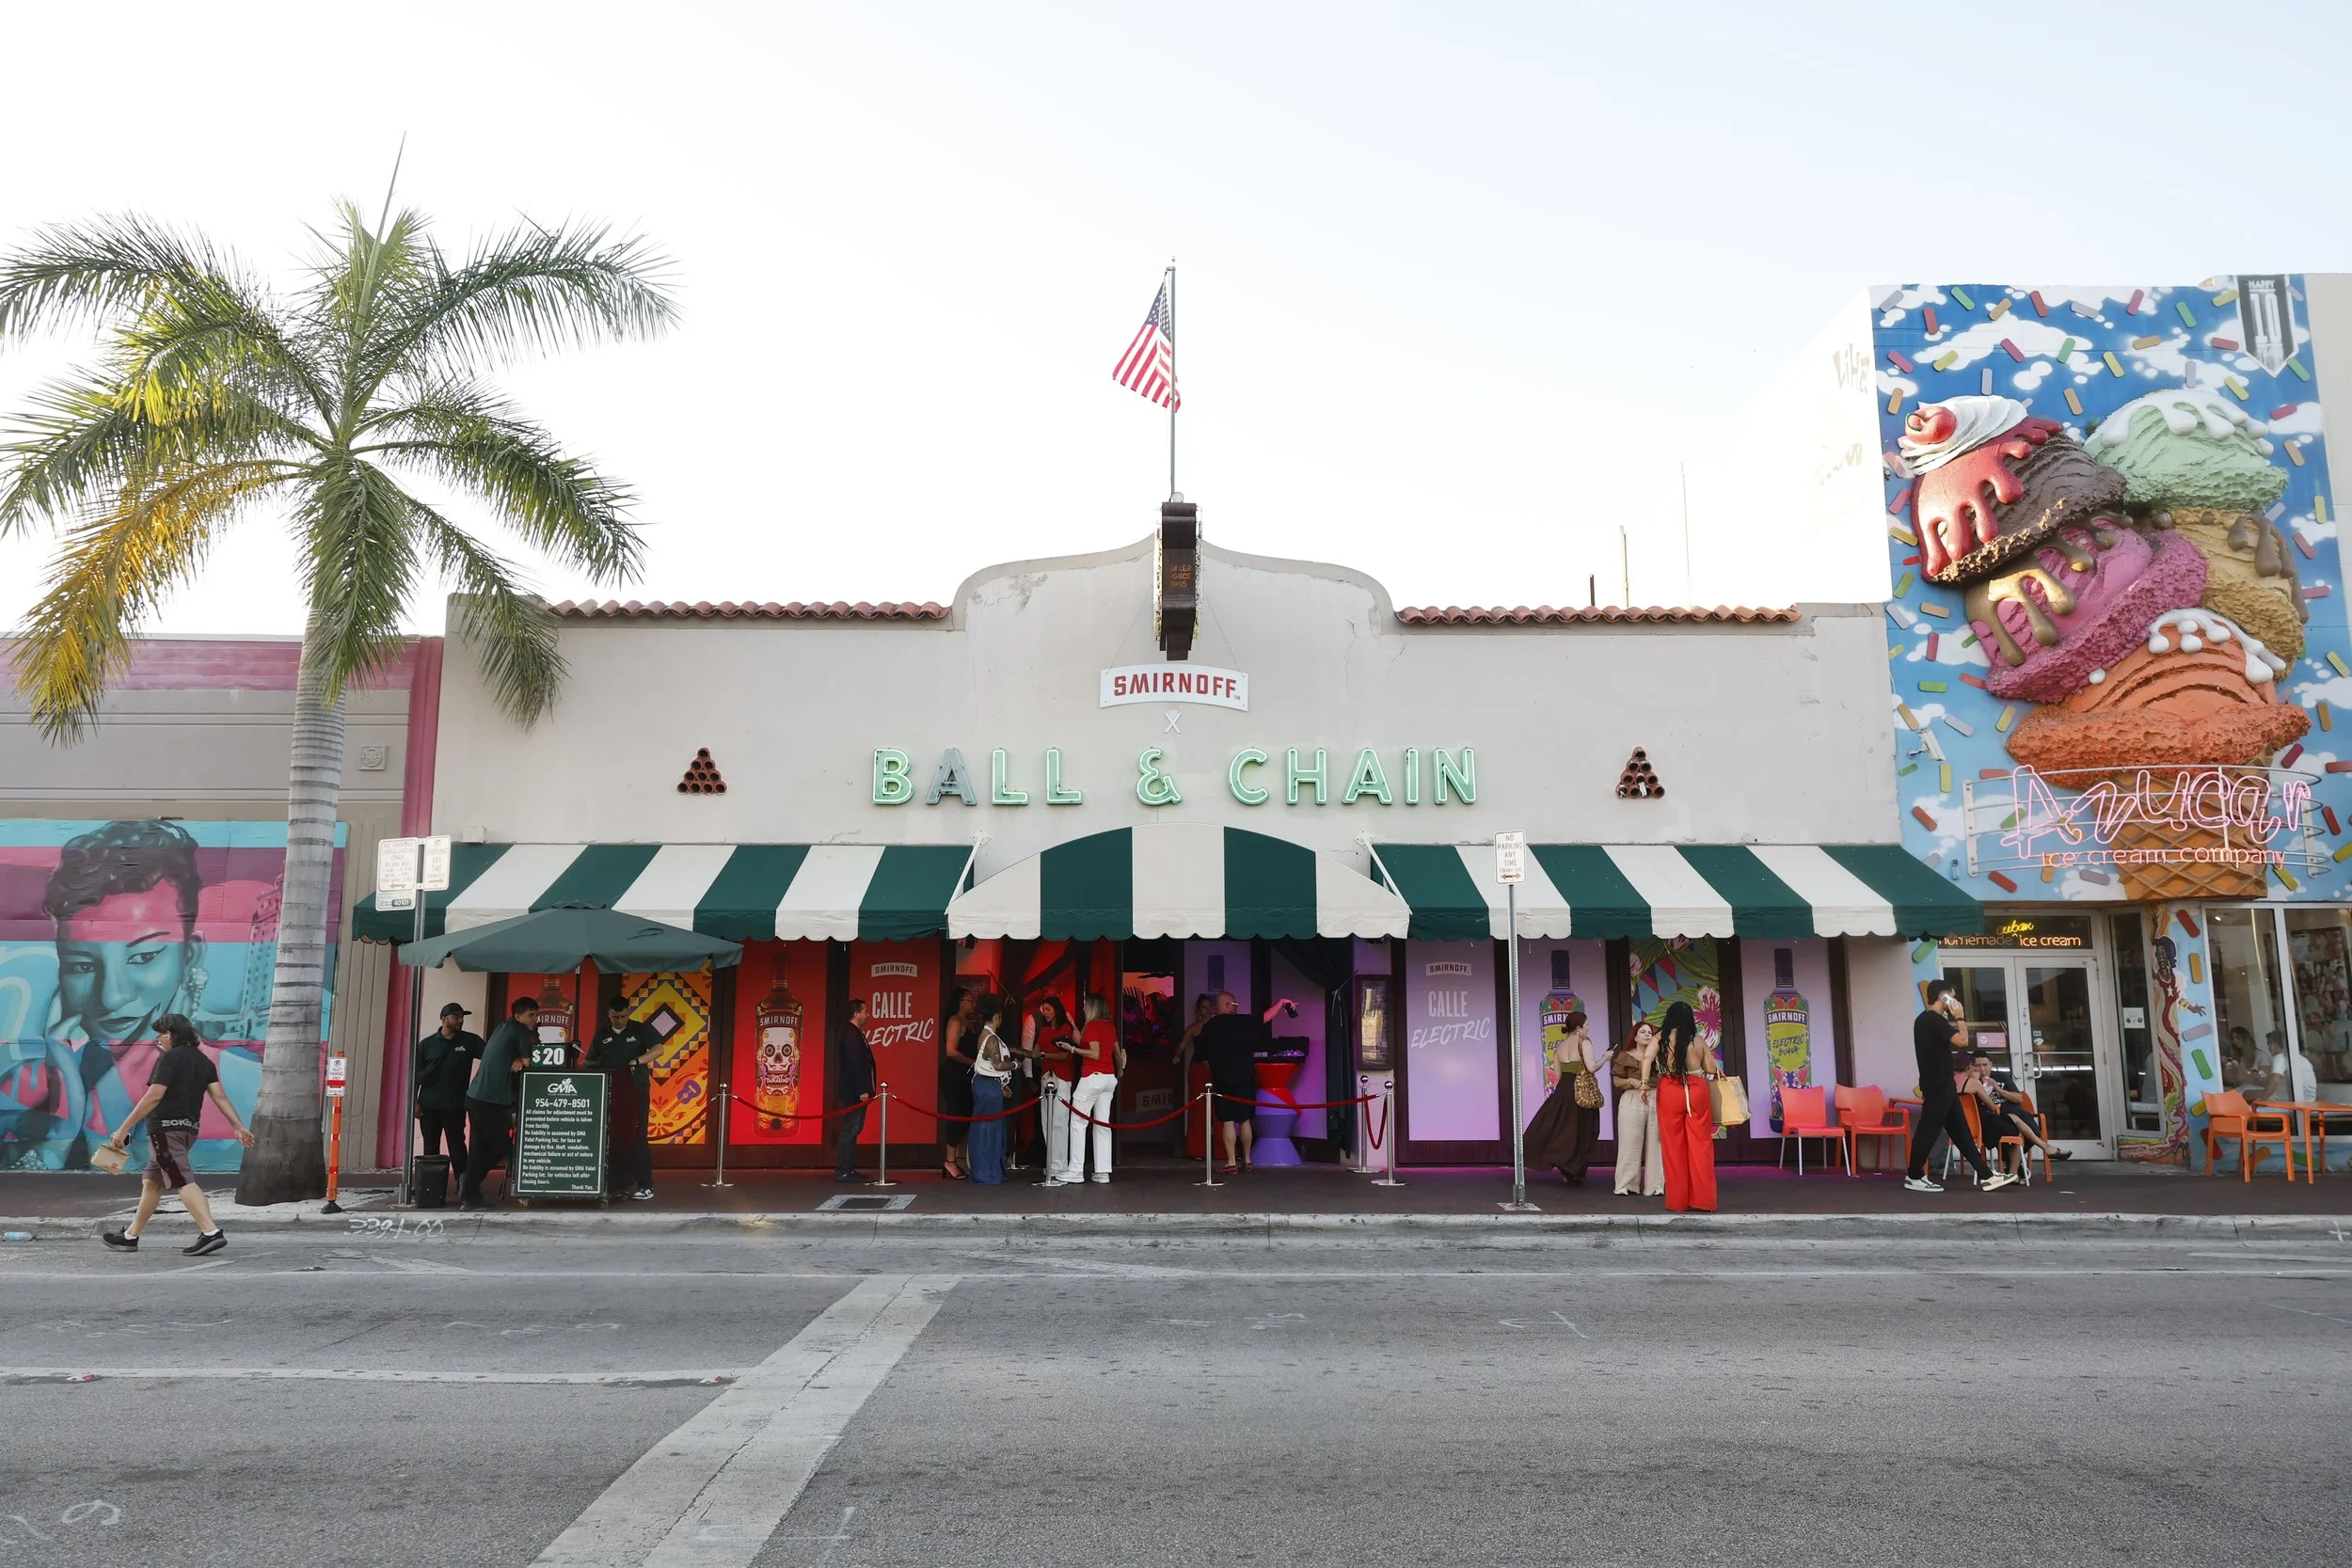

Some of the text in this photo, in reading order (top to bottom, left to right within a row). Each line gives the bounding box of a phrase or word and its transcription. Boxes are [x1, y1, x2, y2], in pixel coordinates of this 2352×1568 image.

[2249, 279, 2276, 289] HAPPY
[1114, 673, 1237, 699] SMIRNOFF
[873, 747, 1477, 806] BALL & CHAIN
[1505, 833, 1515, 842] NO
[1497, 842, 1523, 851] PARKING
[1504, 850, 1516, 859] ANY
[2088, 848, 2167, 865] cream
[2180, 847, 2286, 871] company
[1503, 858, 1518, 867] TIME
[2019, 934, 2038, 947] ice
[2042, 936, 2081, 946] cream
[875, 964, 914, 974] SMIRNOFF
[1429, 964, 1469, 974] SMIRNOFF
[872, 991, 913, 1019] CALLE
[1428, 990, 1468, 1017] CALLE
[759, 1015, 799, 1027] SMIRNOFF
[1768, 1011, 1806, 1023] SMIRNOFF
[863, 1018, 934, 1047] LECTRIC
[1411, 1017, 1490, 1049] ELECTRIC
[1772, 1035, 1804, 1049] ELECTRIC
[547, 1083, 578, 1094] GMA
[534, 1098, 591, 1109] 954-479-8501
